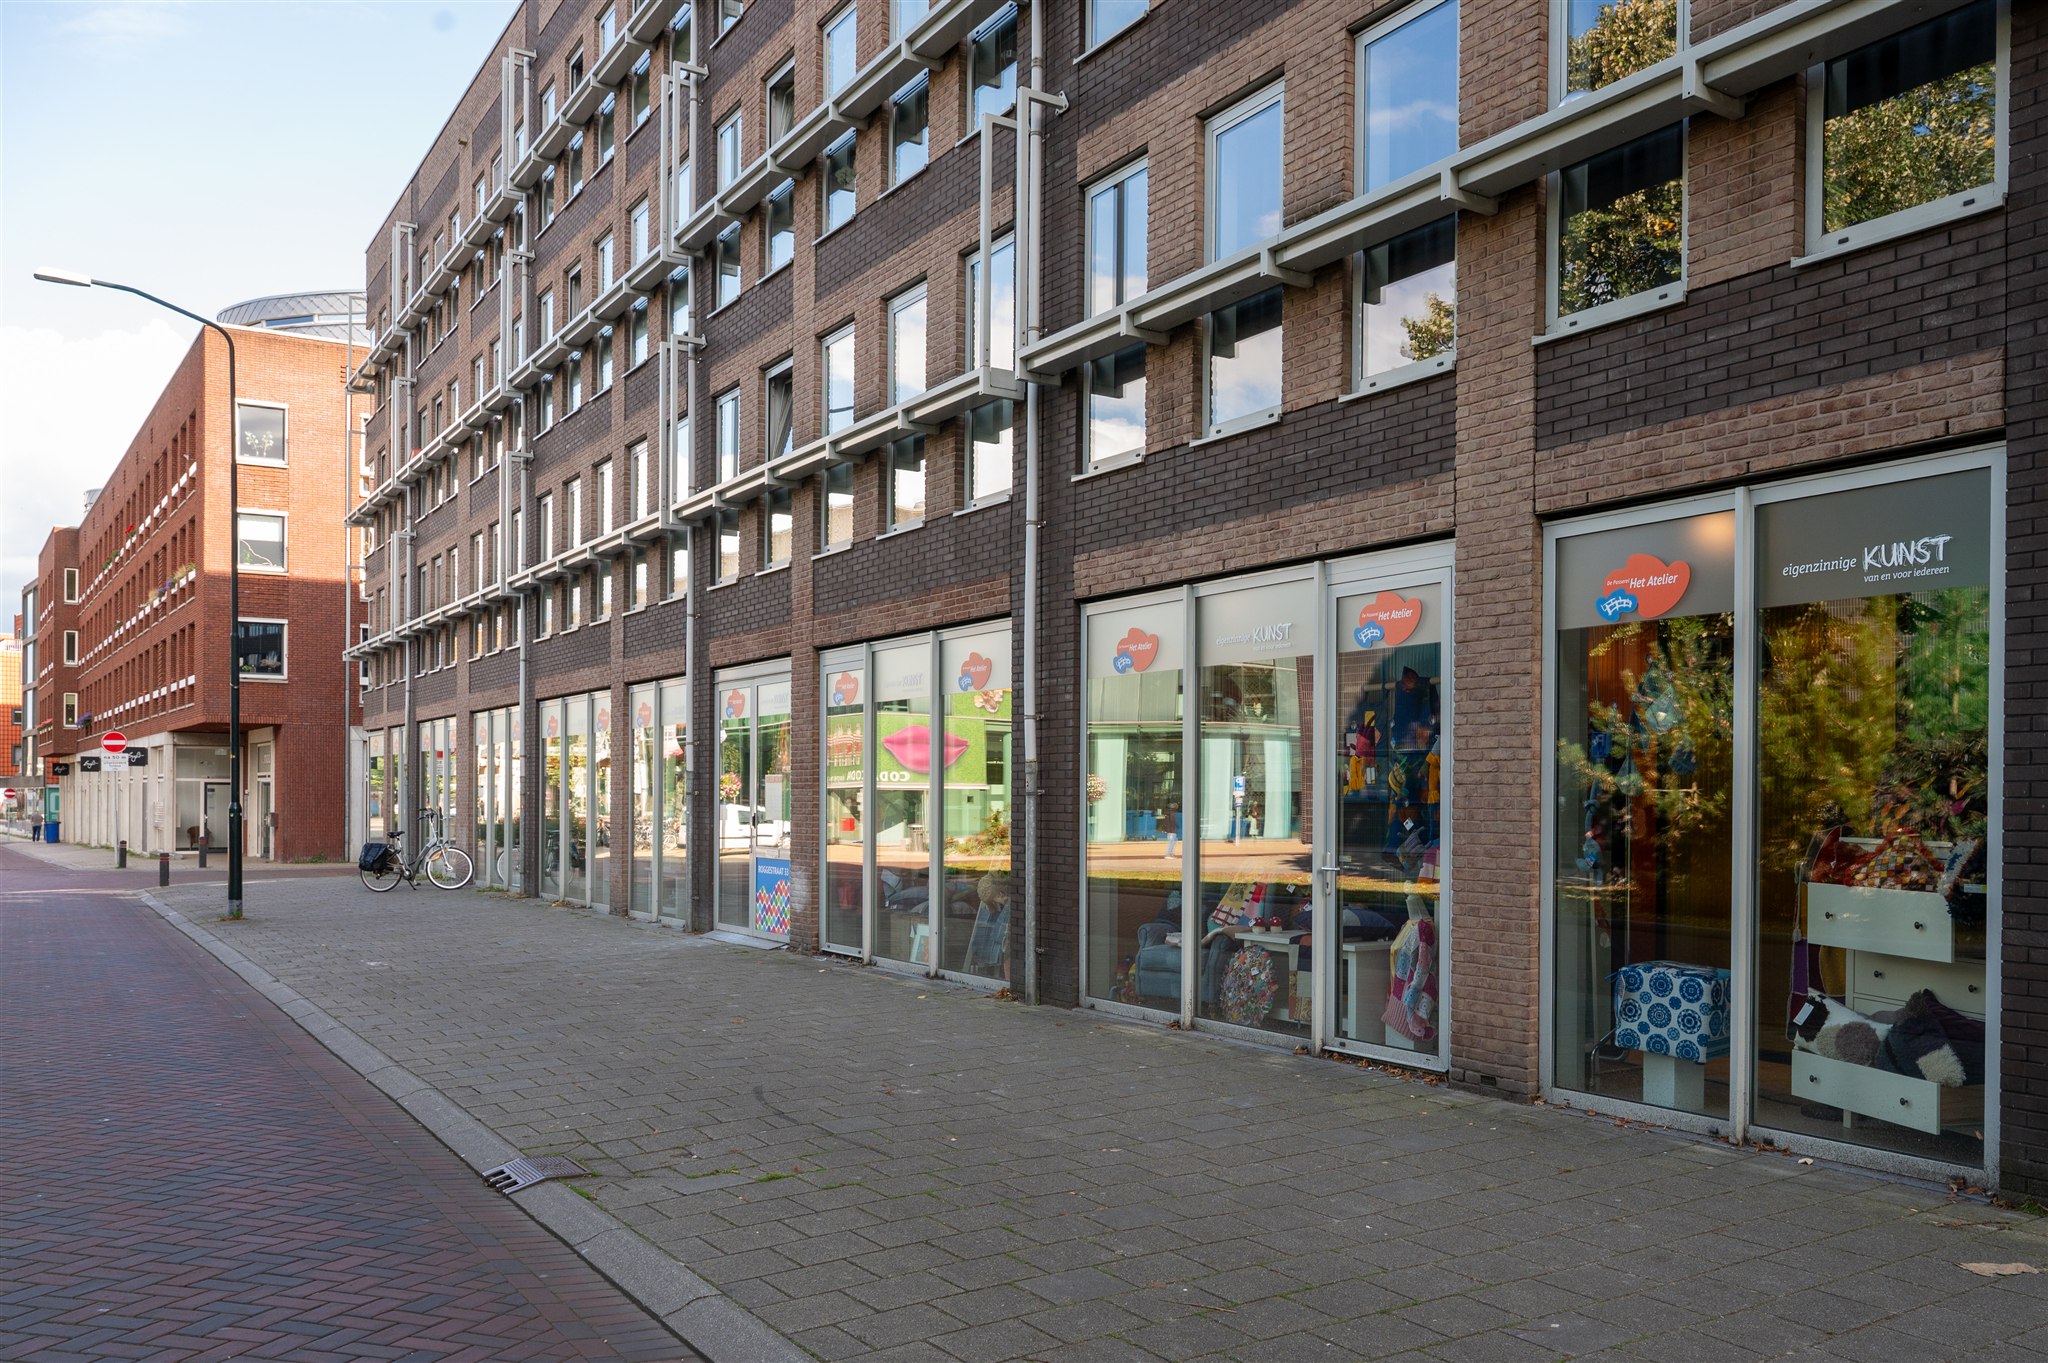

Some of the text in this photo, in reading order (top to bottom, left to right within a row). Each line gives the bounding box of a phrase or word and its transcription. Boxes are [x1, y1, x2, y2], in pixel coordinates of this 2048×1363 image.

[1782, 534, 1952, 577] eigenzinnige KUNST
[1629, 573, 1678, 589] Het Atelier
[1864, 566, 1950, 582] van en voor iedereen
[1378, 611, 1390, 621] Het
[1391, 608, 1413, 619] Atelier
[1253, 623, 1293, 643] KUNST
[758, 865, 784, 876] ROGGESTRAAT
